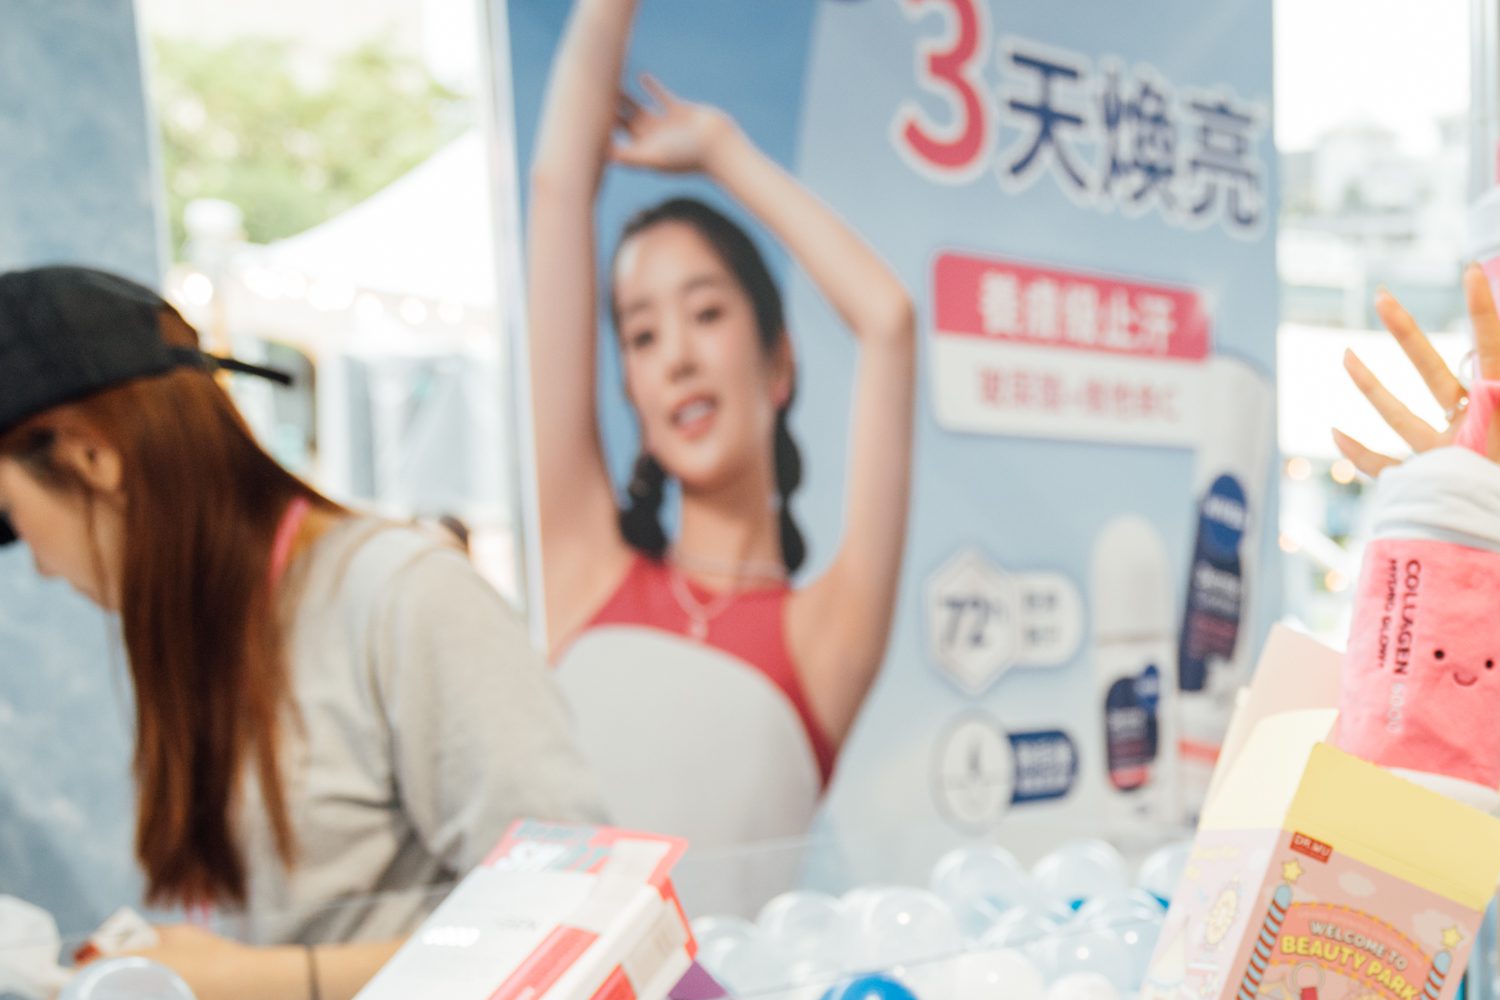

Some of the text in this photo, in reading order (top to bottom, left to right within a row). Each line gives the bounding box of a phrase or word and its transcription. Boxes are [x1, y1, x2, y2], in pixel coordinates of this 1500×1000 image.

[1394, 558, 1422, 676] COLLAGEN
[1281, 935, 1368, 970] BEAUTY
[1310, 920, 1409, 972] WELCOME TO
